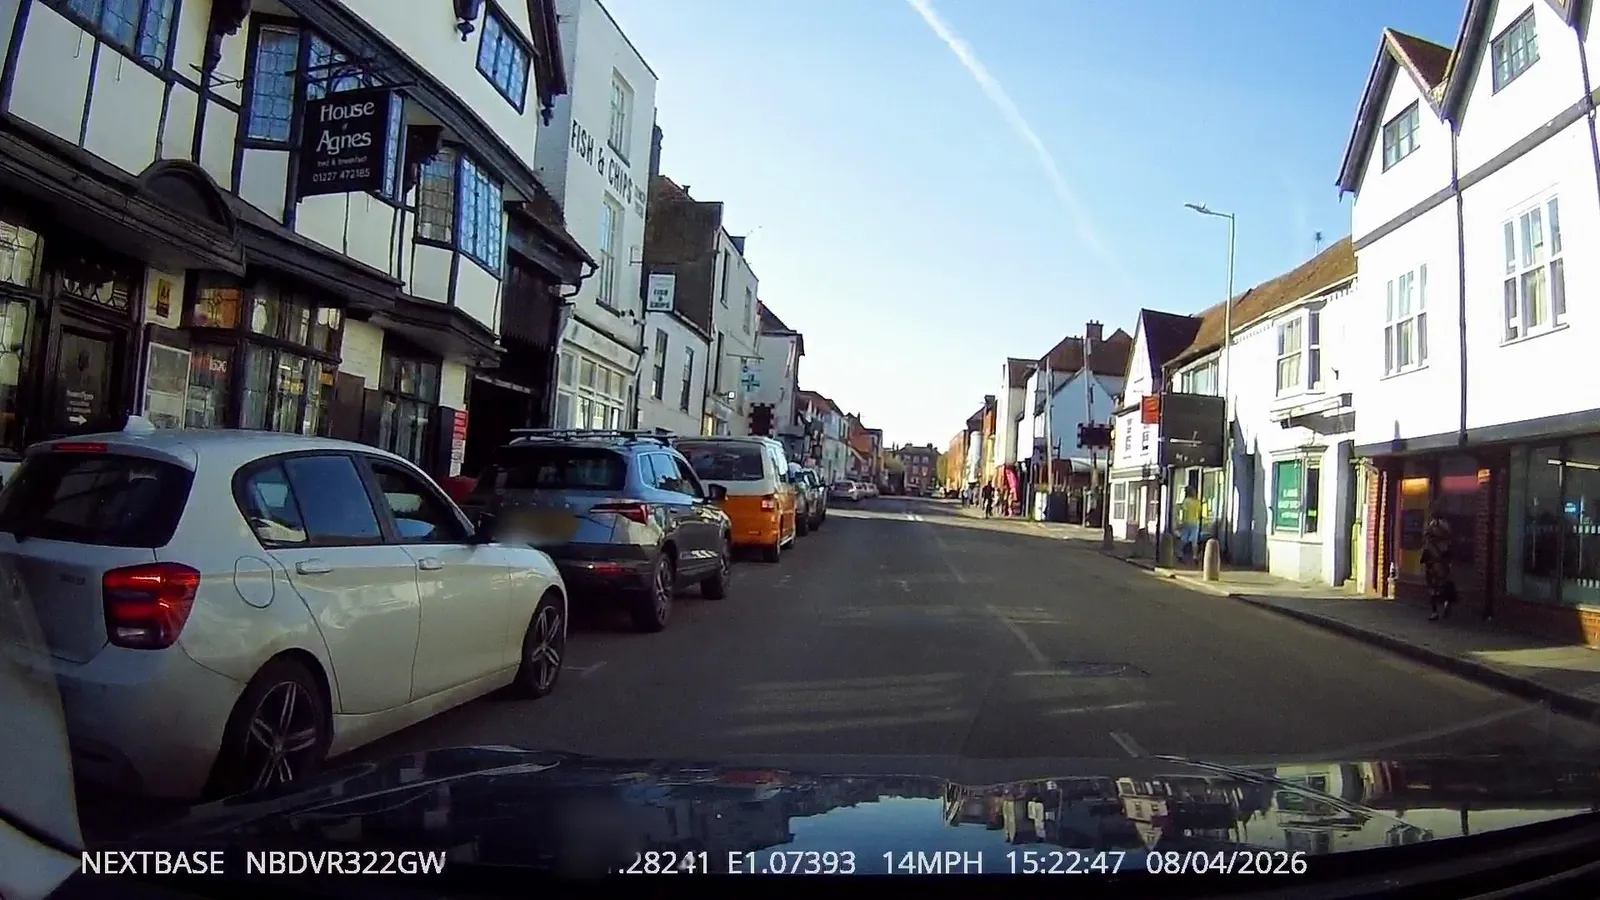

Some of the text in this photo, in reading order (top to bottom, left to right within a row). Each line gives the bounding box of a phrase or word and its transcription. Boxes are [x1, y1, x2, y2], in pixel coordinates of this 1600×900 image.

[320, 102, 375, 122] House
[316, 129, 372, 155] Agnes
[571, 119, 594, 166] FISH
[608, 158, 633, 204] CHIPS
[312, 171, 338, 182] 01227
